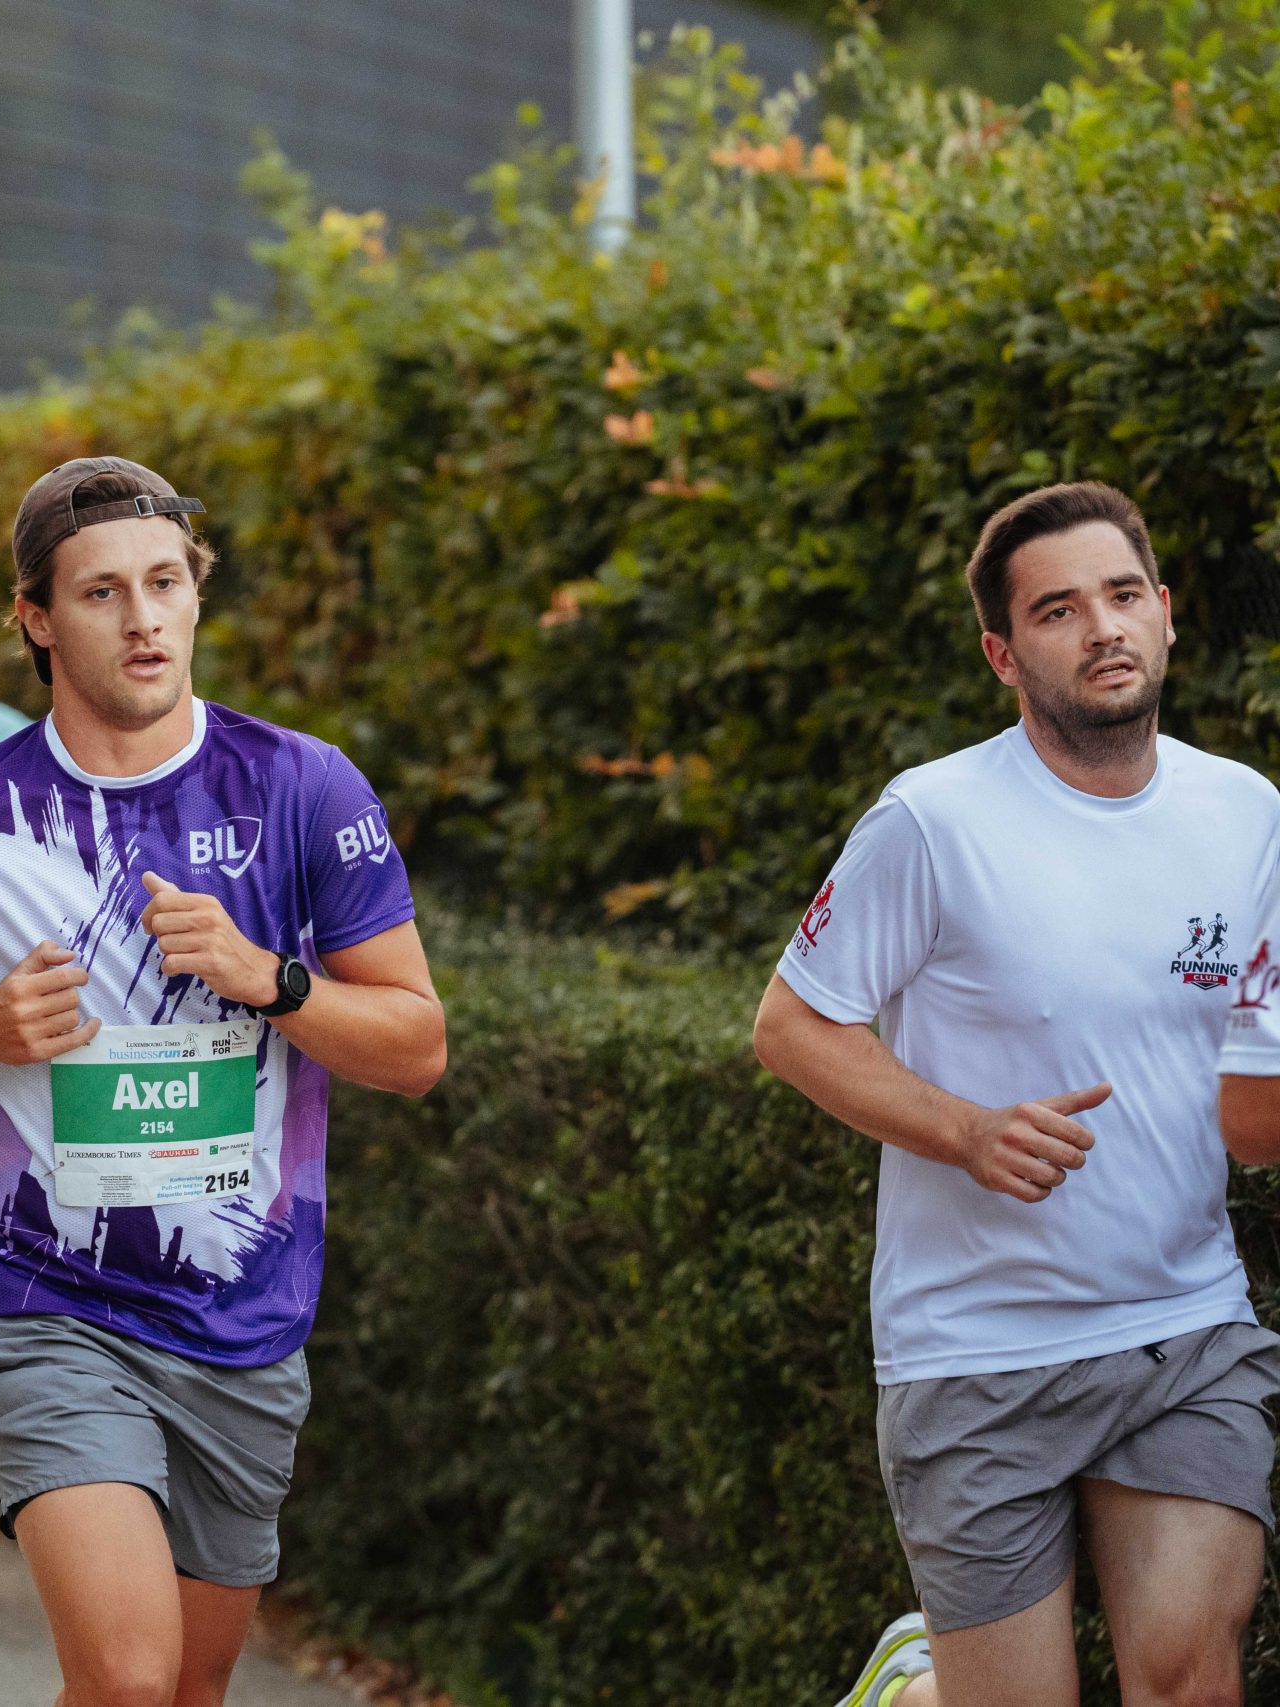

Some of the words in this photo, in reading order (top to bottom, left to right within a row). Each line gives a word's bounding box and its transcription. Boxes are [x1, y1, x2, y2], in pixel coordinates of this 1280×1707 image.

[189, 825, 246, 864] BIL
[335, 815, 386, 863] BIL
[1170, 960, 1238, 977] RUNNING
[1193, 974, 1219, 982] CLUB
[212, 1039, 231, 1048] RUN
[182, 1049, 196, 1058] 26
[213, 1047, 231, 1056] FOR
[112, 1071, 199, 1111] Axel
[140, 1121, 175, 1135] 2154
[156, 1149, 198, 1158] BAUHAUS
[204, 1169, 250, 1194] 2154
